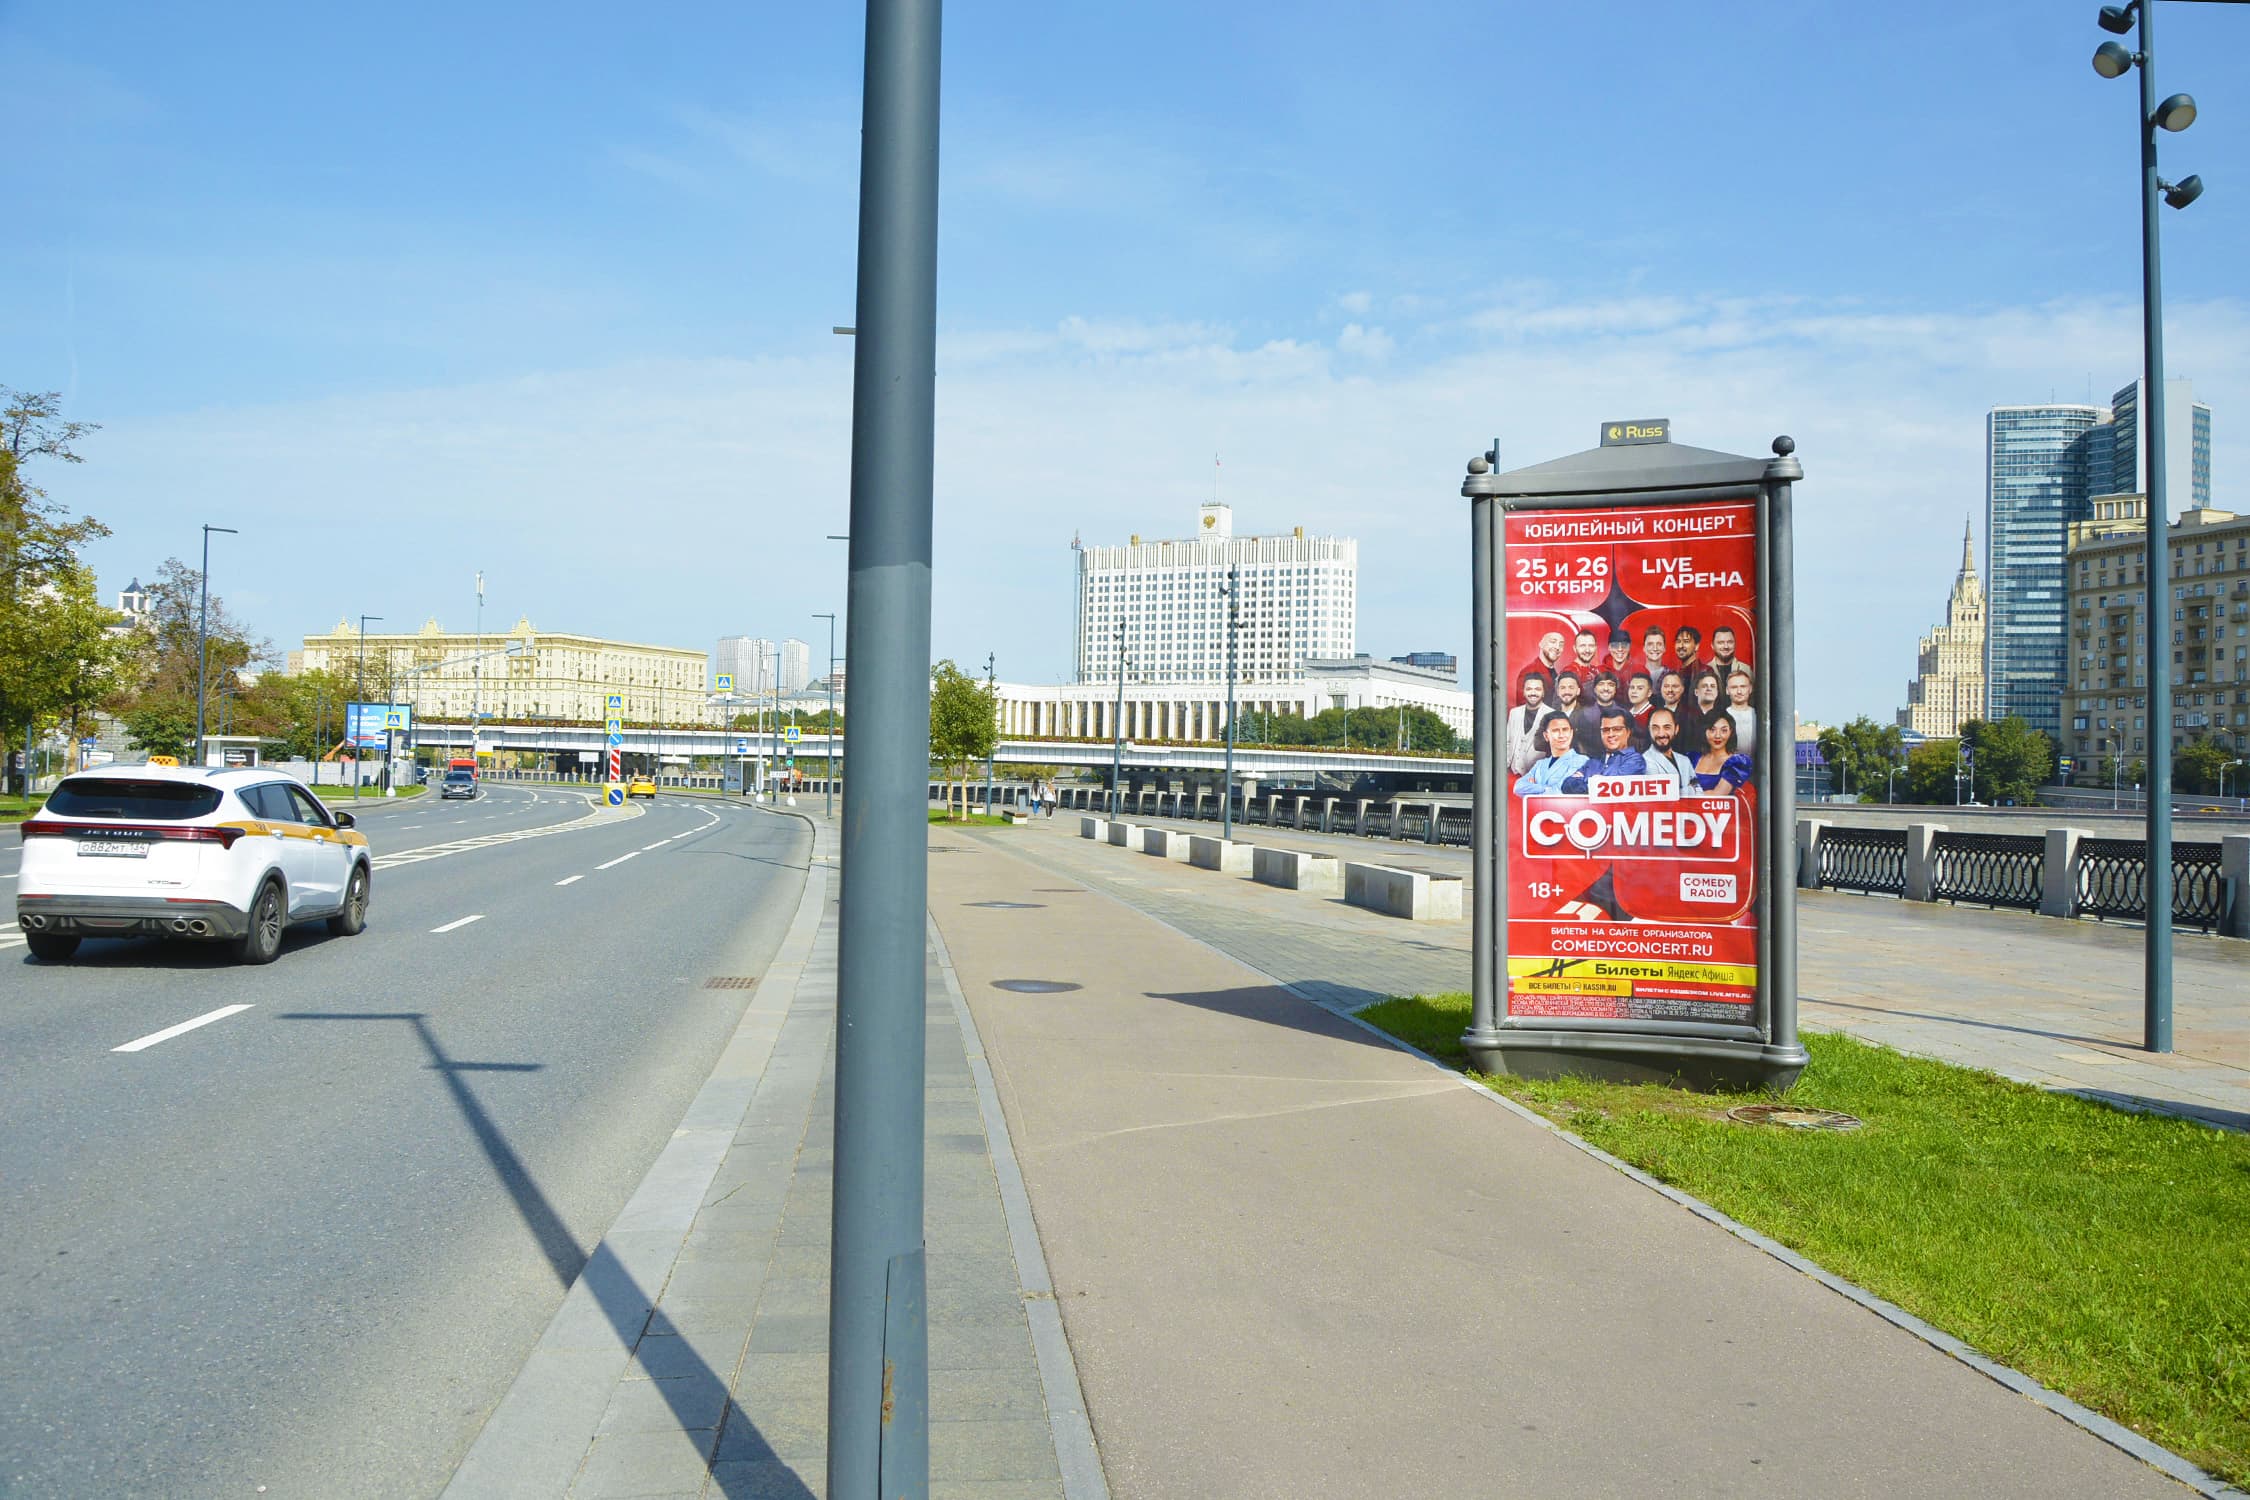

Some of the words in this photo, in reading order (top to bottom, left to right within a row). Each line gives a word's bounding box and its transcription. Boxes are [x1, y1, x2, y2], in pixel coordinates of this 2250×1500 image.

[1625, 425, 1664, 439] Russ
[1525, 517, 1644, 538] ЮБИЛЕЙНЫЙ
[1653, 514, 1736, 535] КОНЦЕРТ
[1515, 558, 1547, 578] 25
[1576, 557, 1608, 577] 26
[1642, 557, 1692, 574] LIVE
[1520, 579, 1604, 595] ОКТЯБРЯ
[1661, 571, 1744, 589] АРЕНА
[1597, 781, 1624, 798] 20
[1628, 779, 1671, 797] ЛЕТ
[1701, 800, 1731, 811] CLUB
[1529, 809, 1732, 848] COMEDY
[1527, 882, 1564, 899] 18+
[1683, 877, 1733, 889] COMEDY
[1690, 888, 1727, 899] RADIO
[1551, 927, 1588, 936] БИЛЕТЫ
[1592, 928, 1605, 936] НА
[1608, 927, 1639, 937] САЙТЕ
[1642, 930, 1713, 940] ОРГАНИЗАТОРА
[1551, 939, 1713, 957] COMEDYCONCERT.RU
[1595, 963, 1663, 977] Билеты
[1667, 966, 1700, 980] Яндекс
[1702, 967, 1734, 982] Афиша
